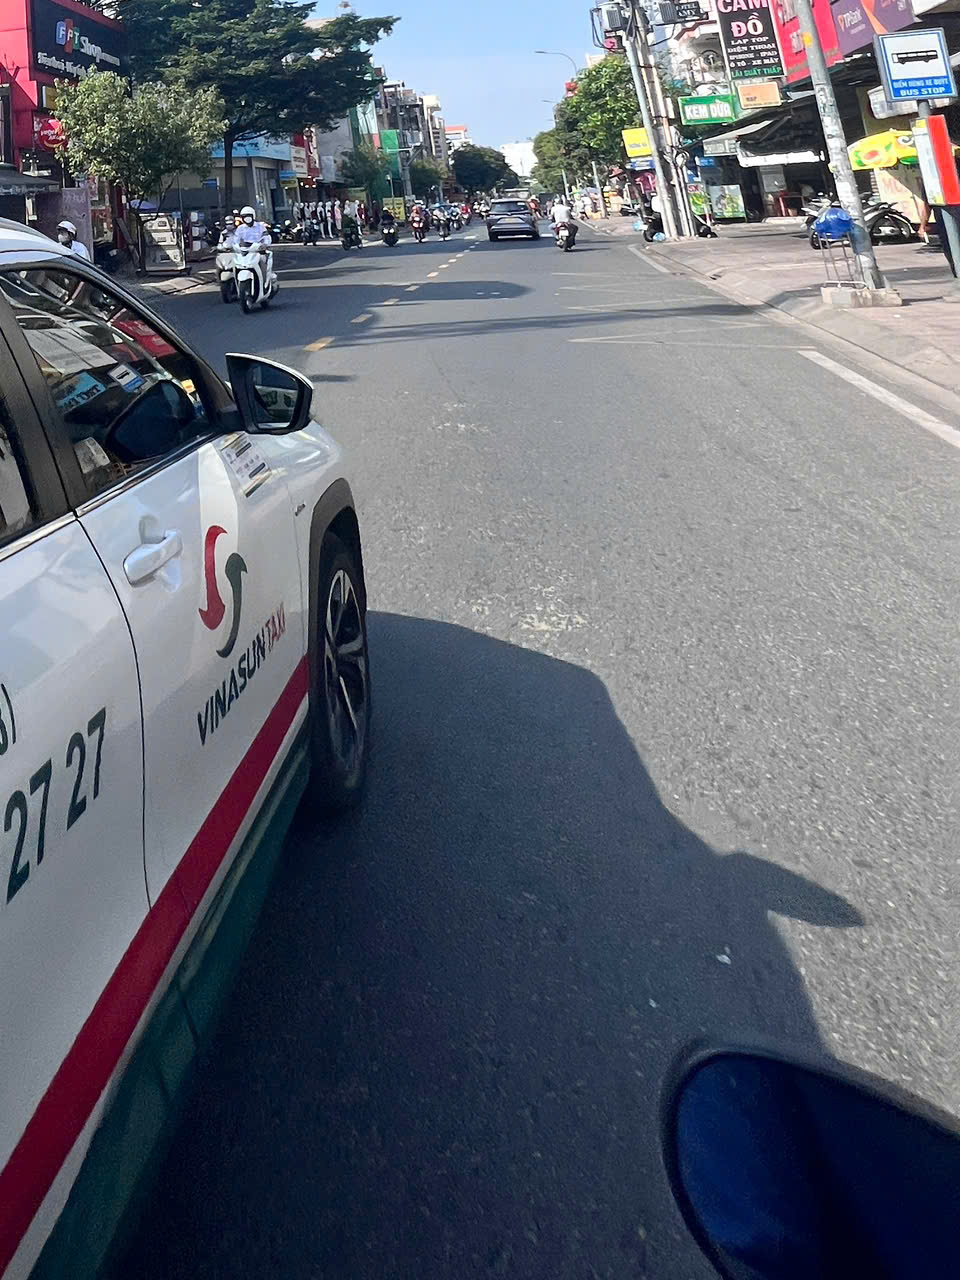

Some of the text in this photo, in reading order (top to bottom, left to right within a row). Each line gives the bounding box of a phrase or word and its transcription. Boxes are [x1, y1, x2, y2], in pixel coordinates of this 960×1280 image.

[731, 12, 763, 37] ĐỒ
[921, 87, 945, 95] STOP
[685, 103, 708, 119] KEM
[197, 627, 266, 746] VINASUN
[3, 758, 52, 904] 27
[65, 706, 107, 831] 27
